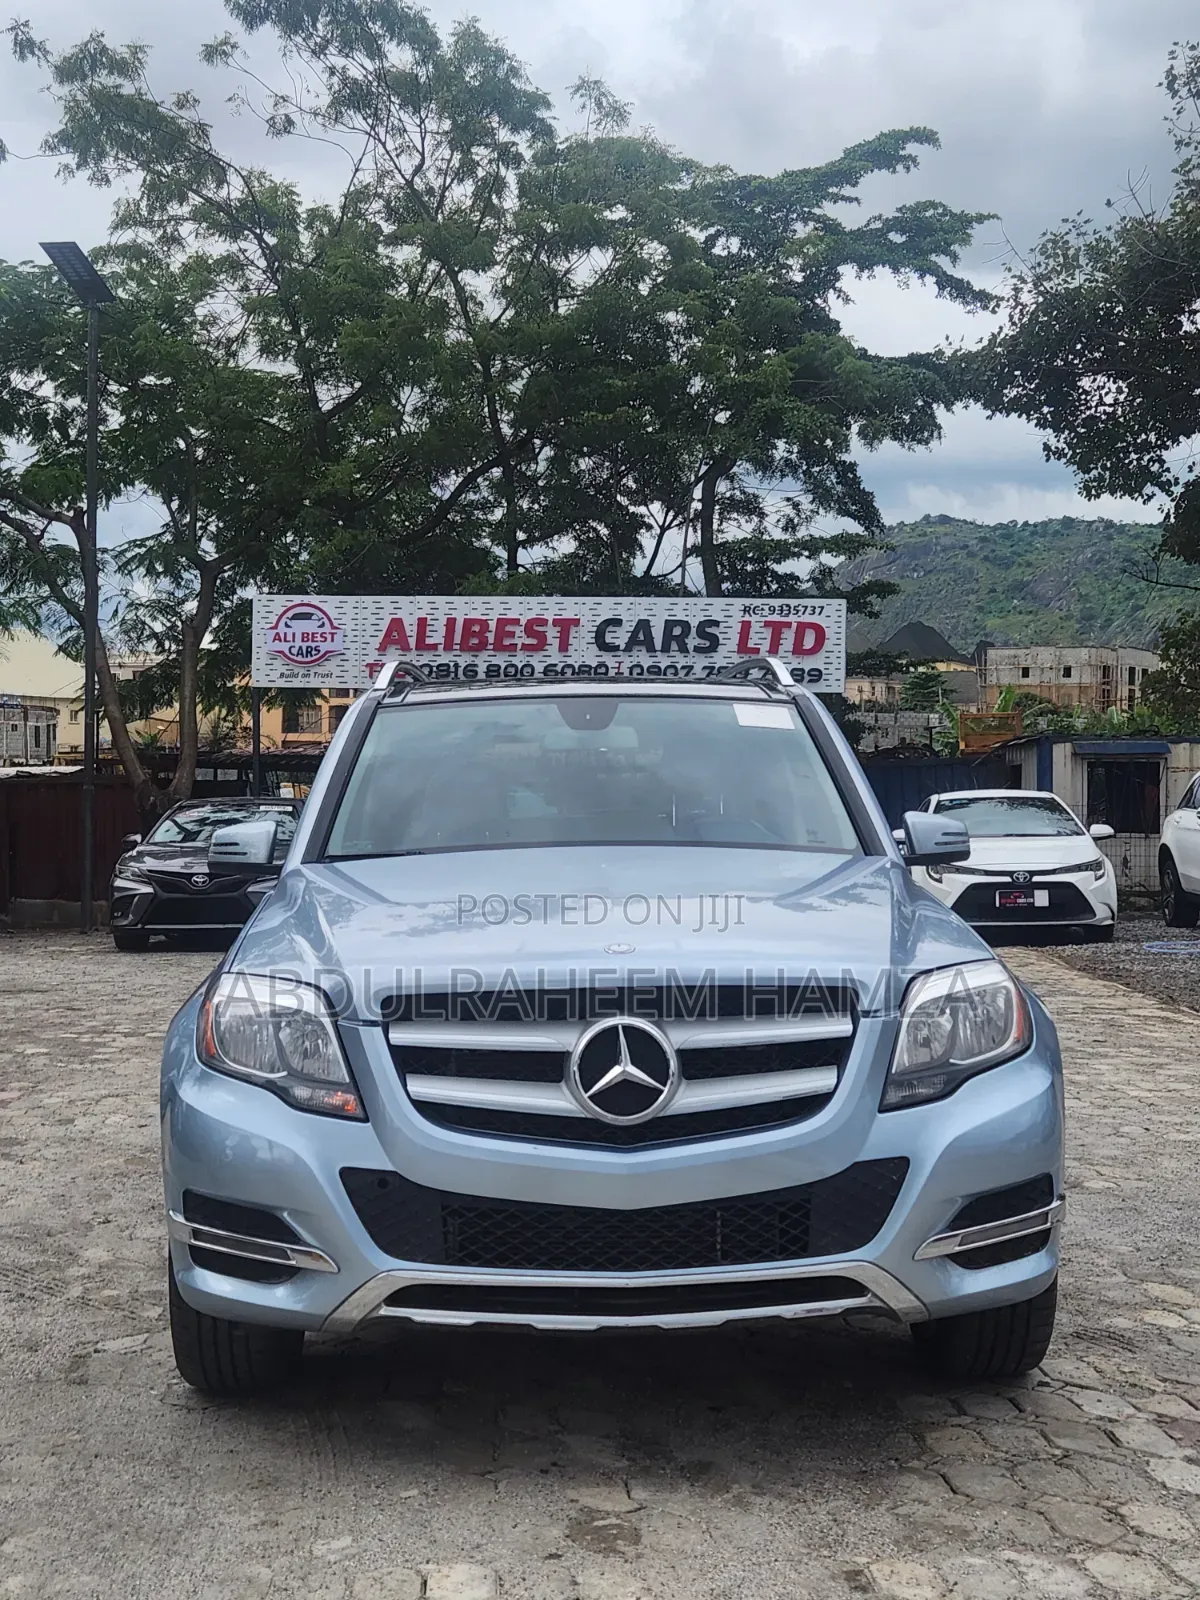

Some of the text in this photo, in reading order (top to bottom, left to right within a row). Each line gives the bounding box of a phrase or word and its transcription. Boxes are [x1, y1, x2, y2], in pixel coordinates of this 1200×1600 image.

[272, 632, 337, 643] ALI BEST
[377, 617, 826, 656] ALIBEST CARS LTD
[288, 645, 321, 659] CARS
